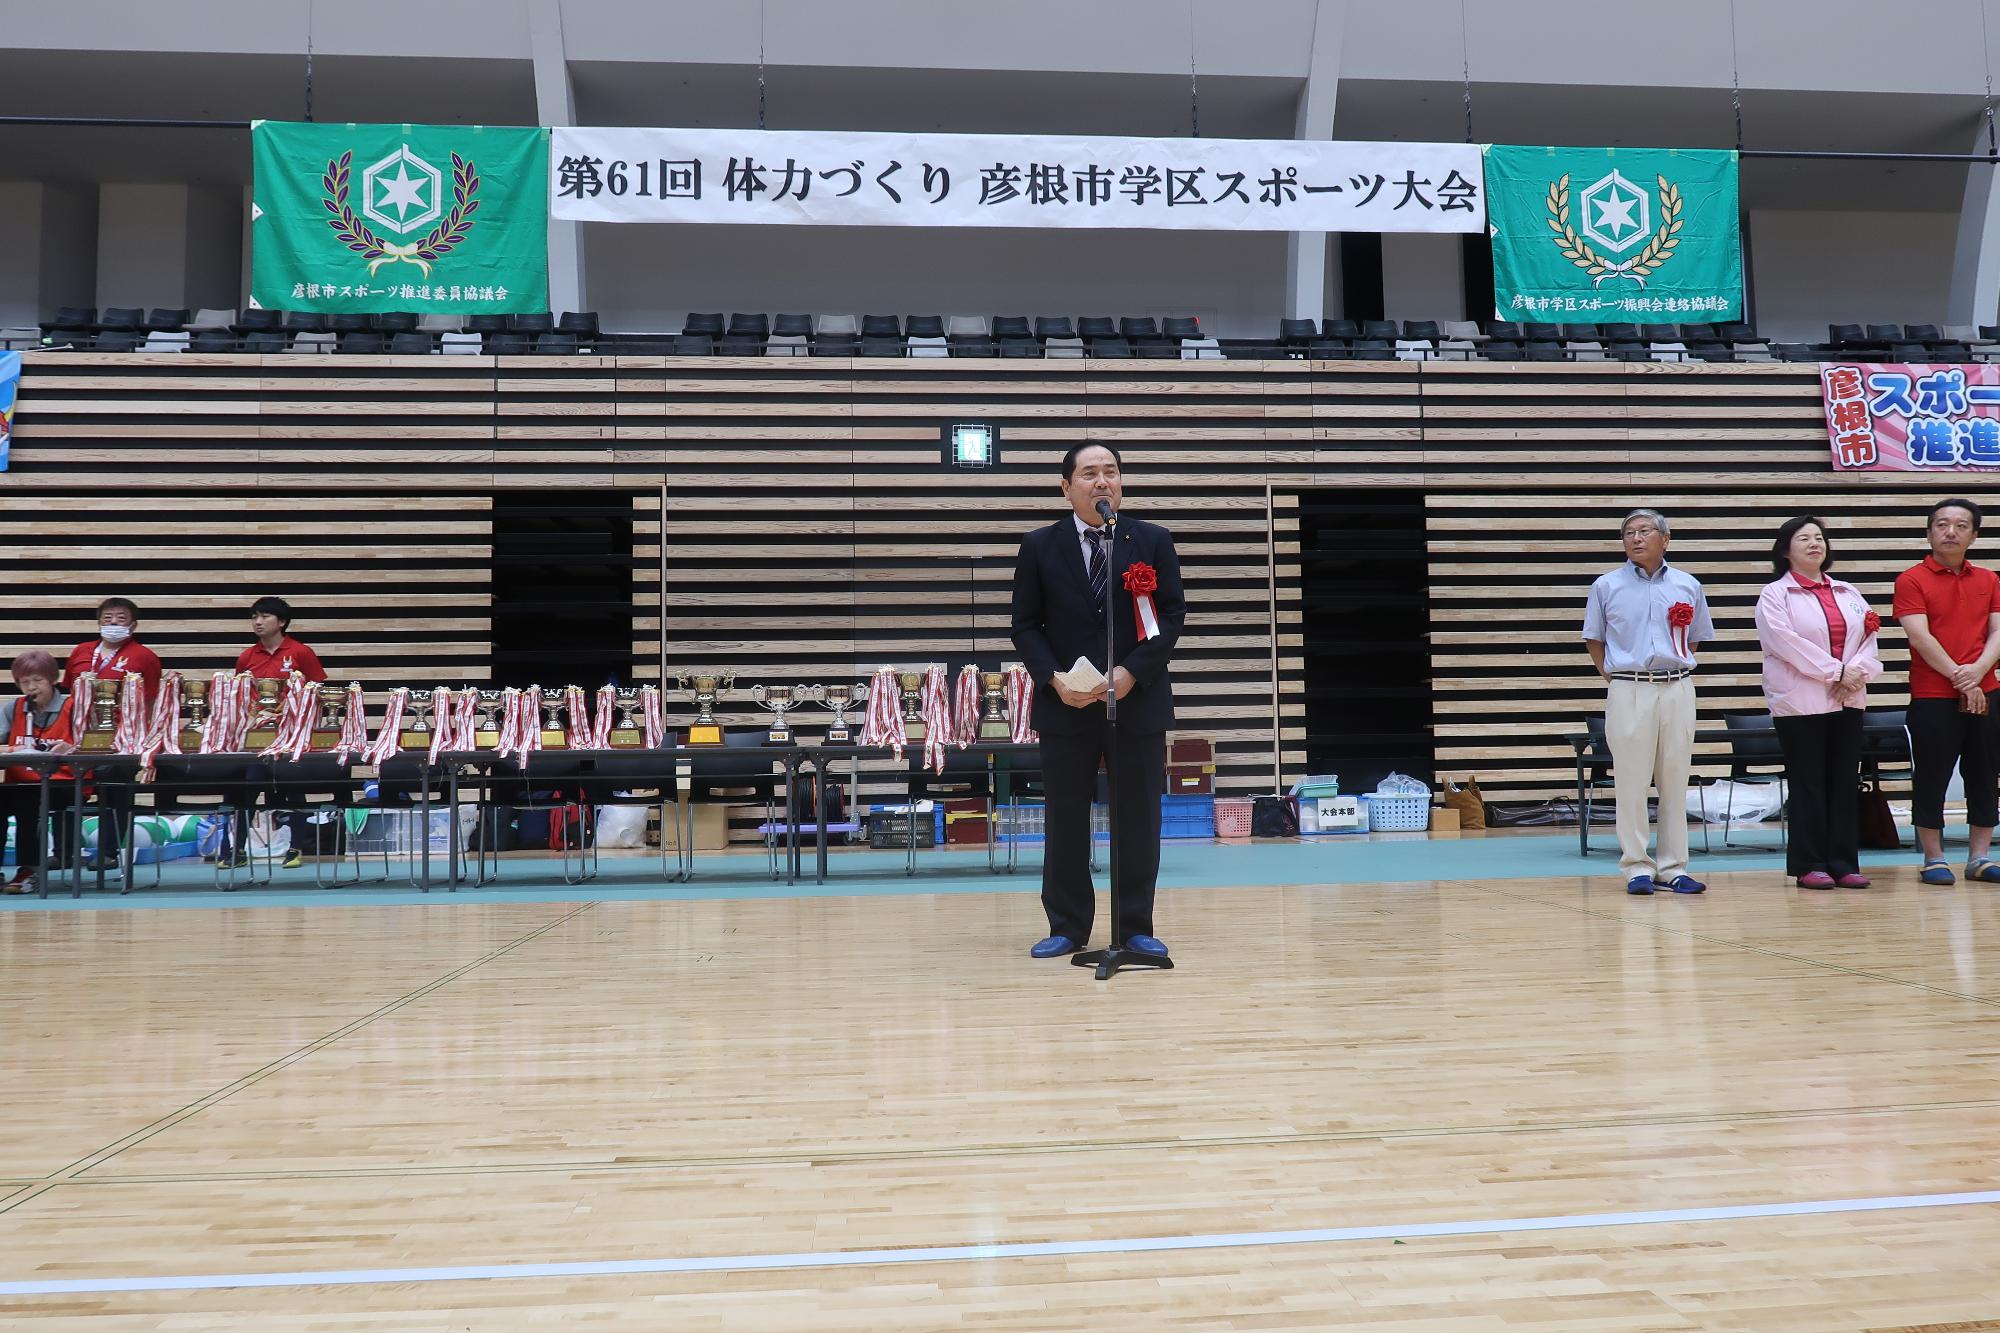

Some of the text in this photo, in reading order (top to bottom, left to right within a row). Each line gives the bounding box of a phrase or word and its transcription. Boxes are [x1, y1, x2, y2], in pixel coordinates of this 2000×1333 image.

[556, 156, 1478, 213] 第61回 体力づくり 彦根市学区スポーツ大会
[291, 282, 509, 301] 彦根市スポーツ推進委員協議会
[1511, 293, 1729, 312] 彦根市学区スポーツ振興会連絡協議会
[1826, 368, 1876, 465] 彦根市
[1909, 420, 2000, 464] 推進
[1321, 807, 1355, 816] 大会本部
